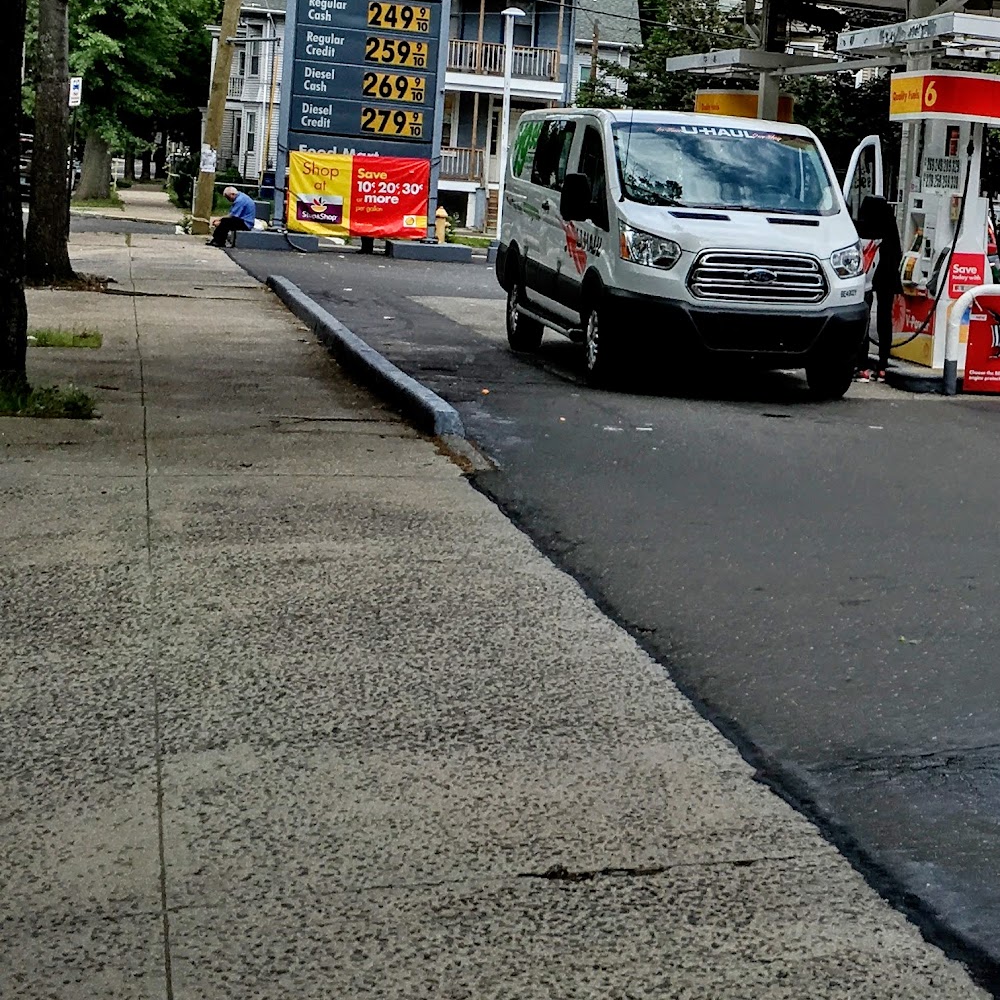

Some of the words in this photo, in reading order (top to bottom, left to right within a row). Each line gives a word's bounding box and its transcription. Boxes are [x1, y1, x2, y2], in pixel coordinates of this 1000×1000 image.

[308, 9, 332, 22] Cash
[368, 2, 414, 29] 249
[307, 31, 345, 46] Regular
[306, 45, 335, 57] Credit
[365, 37, 411, 64] 259
[304, 67, 335, 80] Diesel
[303, 80, 327, 92] Cash
[362, 72, 408, 99] 269
[925, 81, 937, 107] 6
[302, 102, 332, 116] Diesel
[301, 116, 331, 128] Credit
[361, 107, 407, 134] 279
[681, 126, 753, 139] U-HAUL
[302, 161, 340, 180] Shop
[357, 168, 388, 180] Save
[314, 180, 327, 191] at
[364, 195, 400, 204] more
[952, 264, 978, 274] Save
